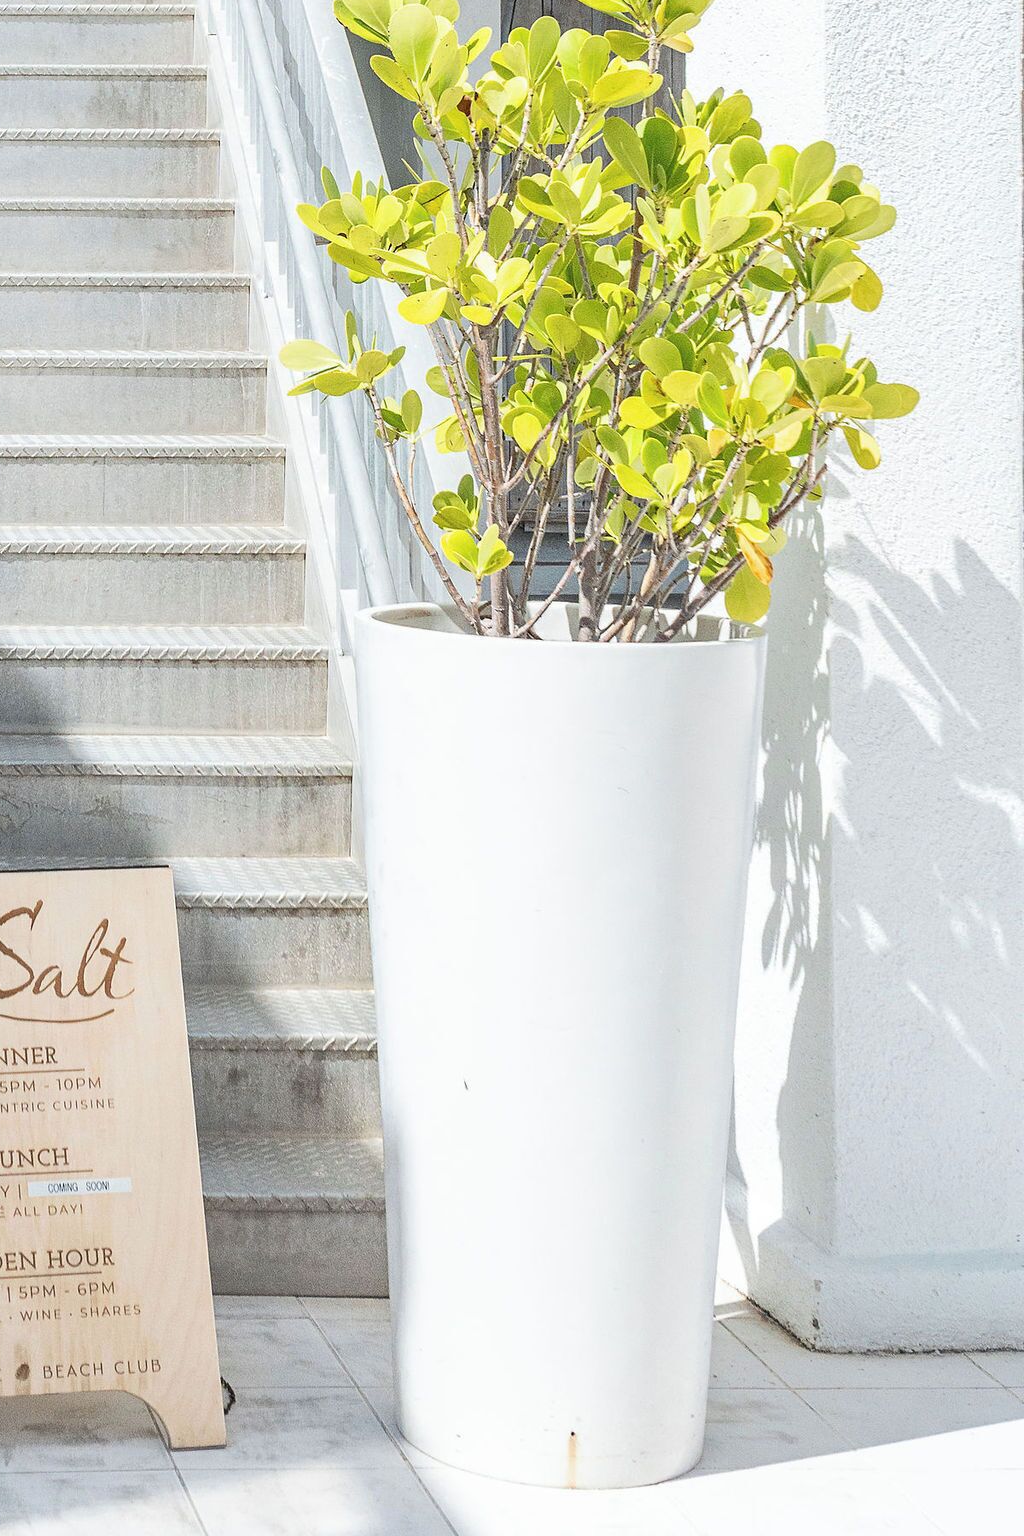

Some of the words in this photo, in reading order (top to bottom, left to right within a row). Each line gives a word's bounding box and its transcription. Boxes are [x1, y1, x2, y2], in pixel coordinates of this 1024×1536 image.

[56, 1076, 103, 1092] 10PM
[52, 1097, 116, 1112] CUISINE
[47, 1181, 80, 1194] COMING
[12, 1204, 41, 1217] ALL
[47, 1202, 85, 1216] DAY!
[46, 1247, 116, 1269] HOUR
[18, 1284, 57, 1300] 5PM
[77, 1281, 116, 1297] 6PM
[19, 1308, 62, 1322] WINE
[80, 1304, 142, 1319] SHARES
[42, 1363, 105, 1380] BEACH
[114, 1358, 162, 1375] CLUB
